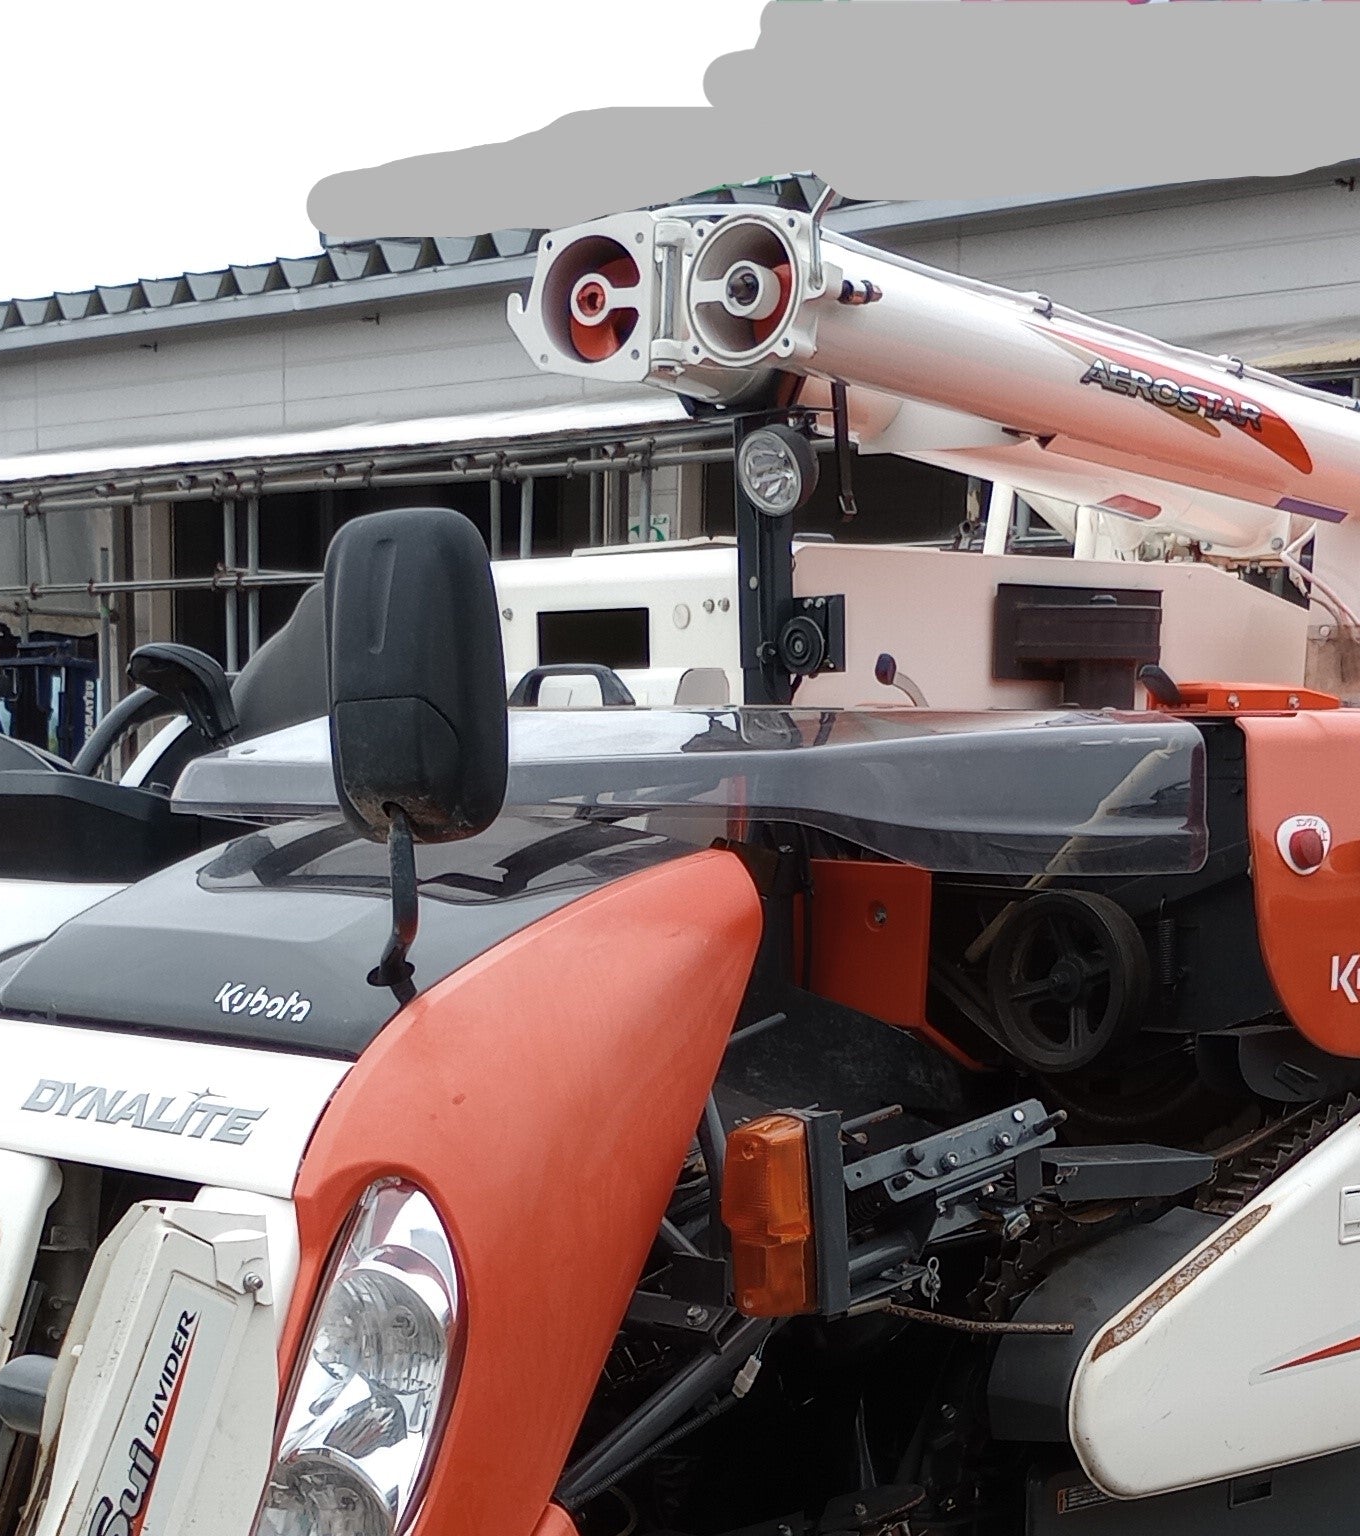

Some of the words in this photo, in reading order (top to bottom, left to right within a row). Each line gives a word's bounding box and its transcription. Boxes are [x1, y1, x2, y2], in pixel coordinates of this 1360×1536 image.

[1080, 358, 1263, 433] AEROSTAR
[214, 981, 312, 1023] Kubota
[145, 1309, 198, 1437] DIVIDER
